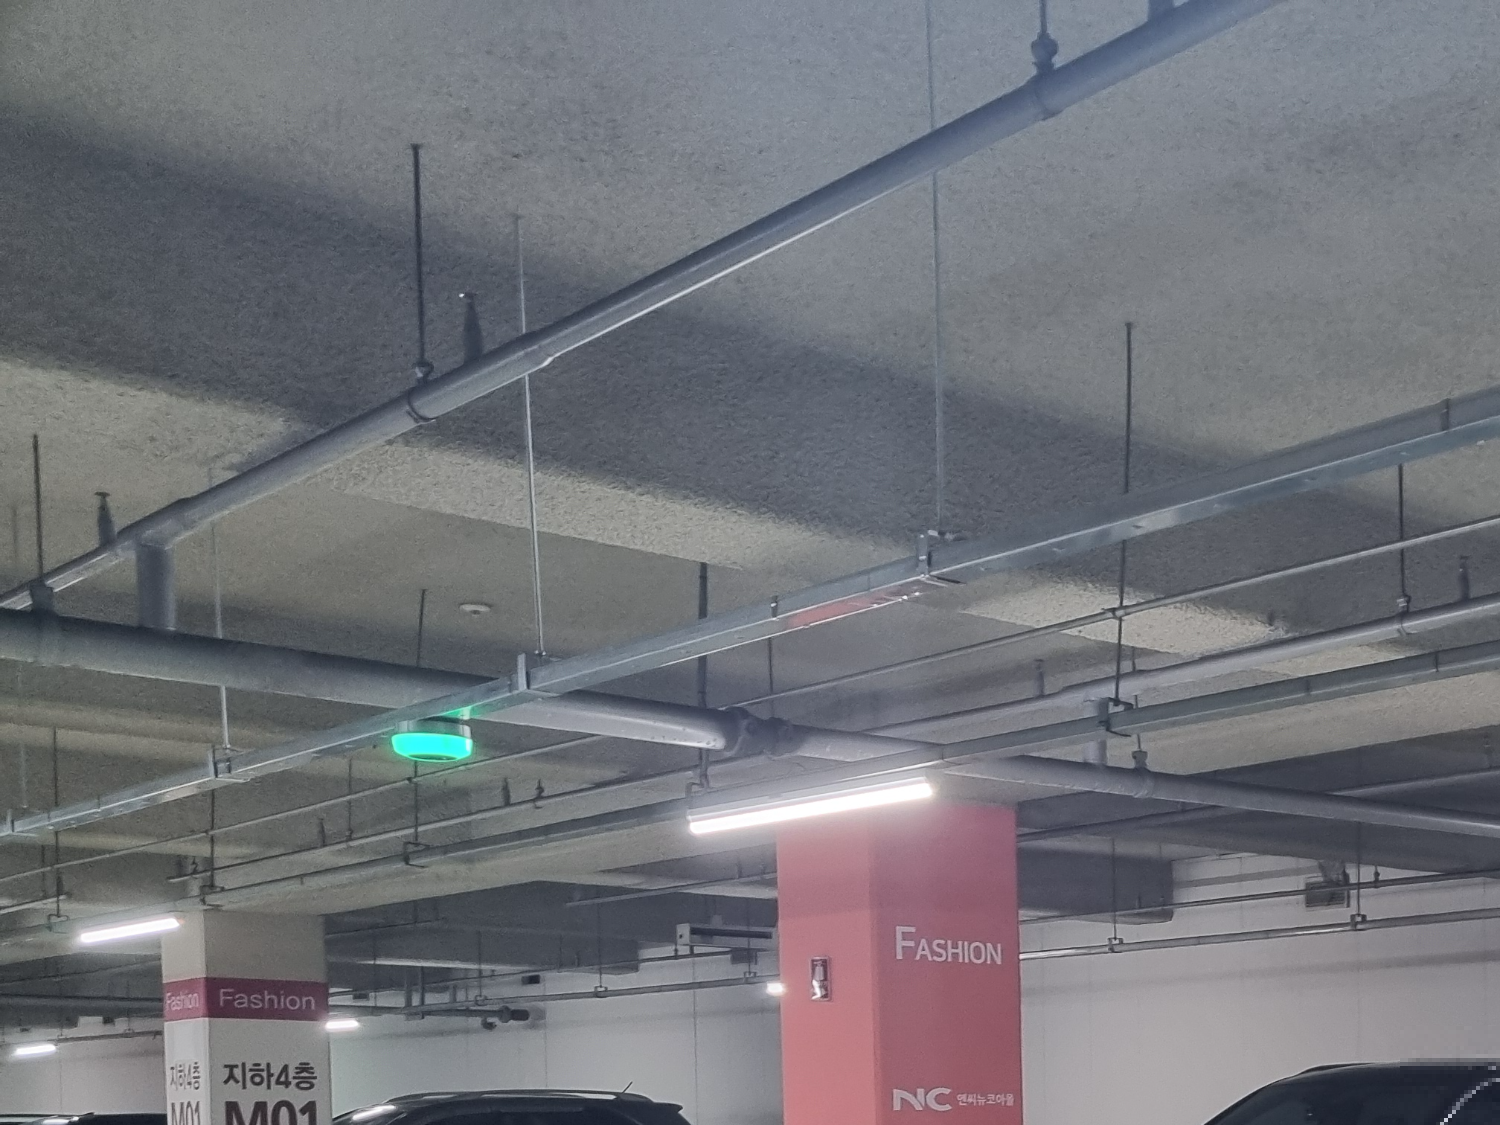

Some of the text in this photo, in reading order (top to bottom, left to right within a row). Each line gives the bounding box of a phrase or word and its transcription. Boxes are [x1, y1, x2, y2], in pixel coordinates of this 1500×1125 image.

[166, 990, 199, 1011] Fashion
[219, 988, 316, 1011] Fashion
[169, 1061, 202, 1091] 지하4층
[222, 1061, 318, 1091] 지하4층
[892, 1087, 952, 1112] NC
